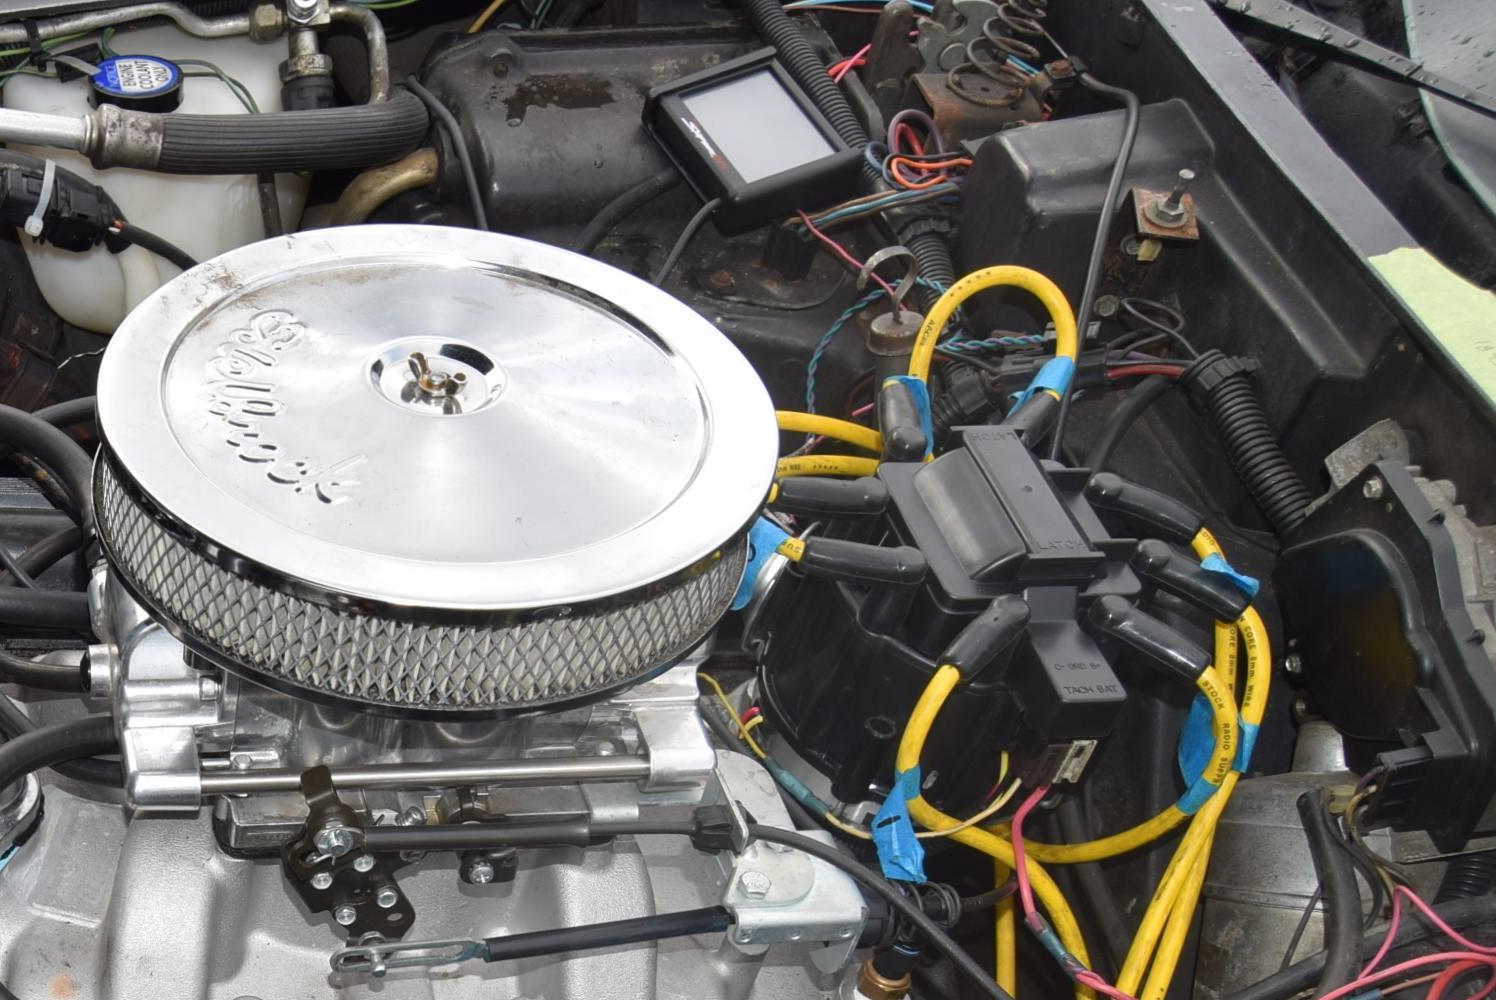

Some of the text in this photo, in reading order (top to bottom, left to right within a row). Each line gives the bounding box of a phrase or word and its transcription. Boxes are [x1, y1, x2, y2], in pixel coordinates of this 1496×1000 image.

[118, 63, 137, 87] ENGINE
[134, 60, 154, 90] COOLANT
[152, 65, 169, 83] ONLY
[205, 308, 367, 506] Edelbrock
[1035, 539, 1086, 550] LATCH
[1243, 626, 1256, 650] CORE
[1063, 684, 1119, 695] TACH BAT
[1243, 683, 1254, 708] WIRE
[1201, 680, 1225, 710] STOCK
[1222, 722, 1232, 751] RADIO
